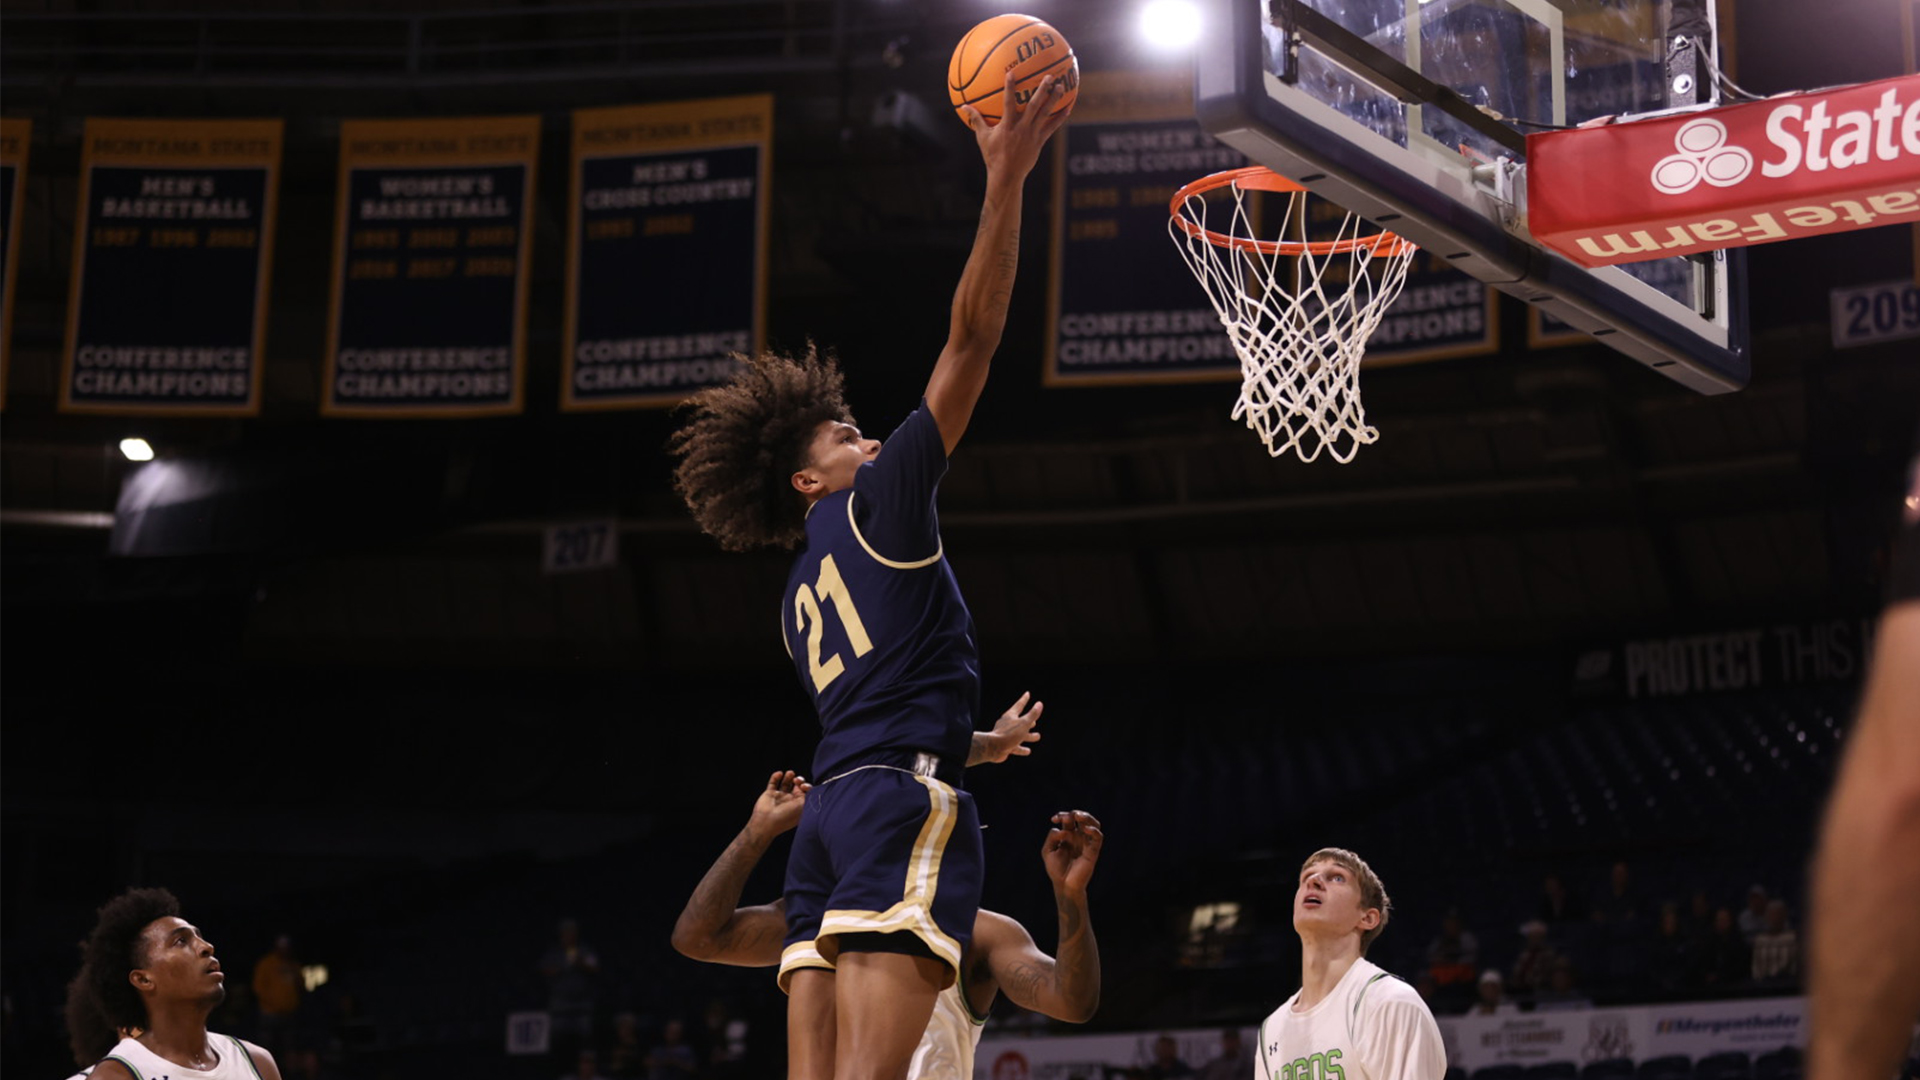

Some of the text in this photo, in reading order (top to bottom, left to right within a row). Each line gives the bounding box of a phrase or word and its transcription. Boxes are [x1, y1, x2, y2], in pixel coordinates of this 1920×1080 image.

[1016, 32, 1055, 63] EVO
[1761, 88, 1920, 178] State
[632, 158, 708, 184] MEN'S
[1069, 150, 1245, 175] CROSS COUNTRY
[141, 176, 215, 197] MEN'S
[380, 175, 494, 196] WOMEN'S
[584, 177, 754, 210] CROSS COUNTRY
[101, 197, 251, 219] BASKETBALL
[360, 197, 512, 219] BASKETBALL
[1575, 187, 1920, 257] ate Farm
[1060, 309, 1240, 338] CONFERENC
[1848, 287, 1920, 336] 209
[77, 345, 247, 369] CONFERENCE
[338, 347, 508, 371] CONFERENCE
[576, 330, 749, 364] CONFERENCE
[75, 370, 247, 396] CHAMPIONS
[336, 371, 509, 397] CHAMPIONS
[555, 526, 606, 565] 207
[795, 553, 874, 695] 21
[1624, 629, 1762, 698] PROTECT
[1773, 619, 1854, 683] THIS
[1274, 1048, 1345, 1080] GOS
